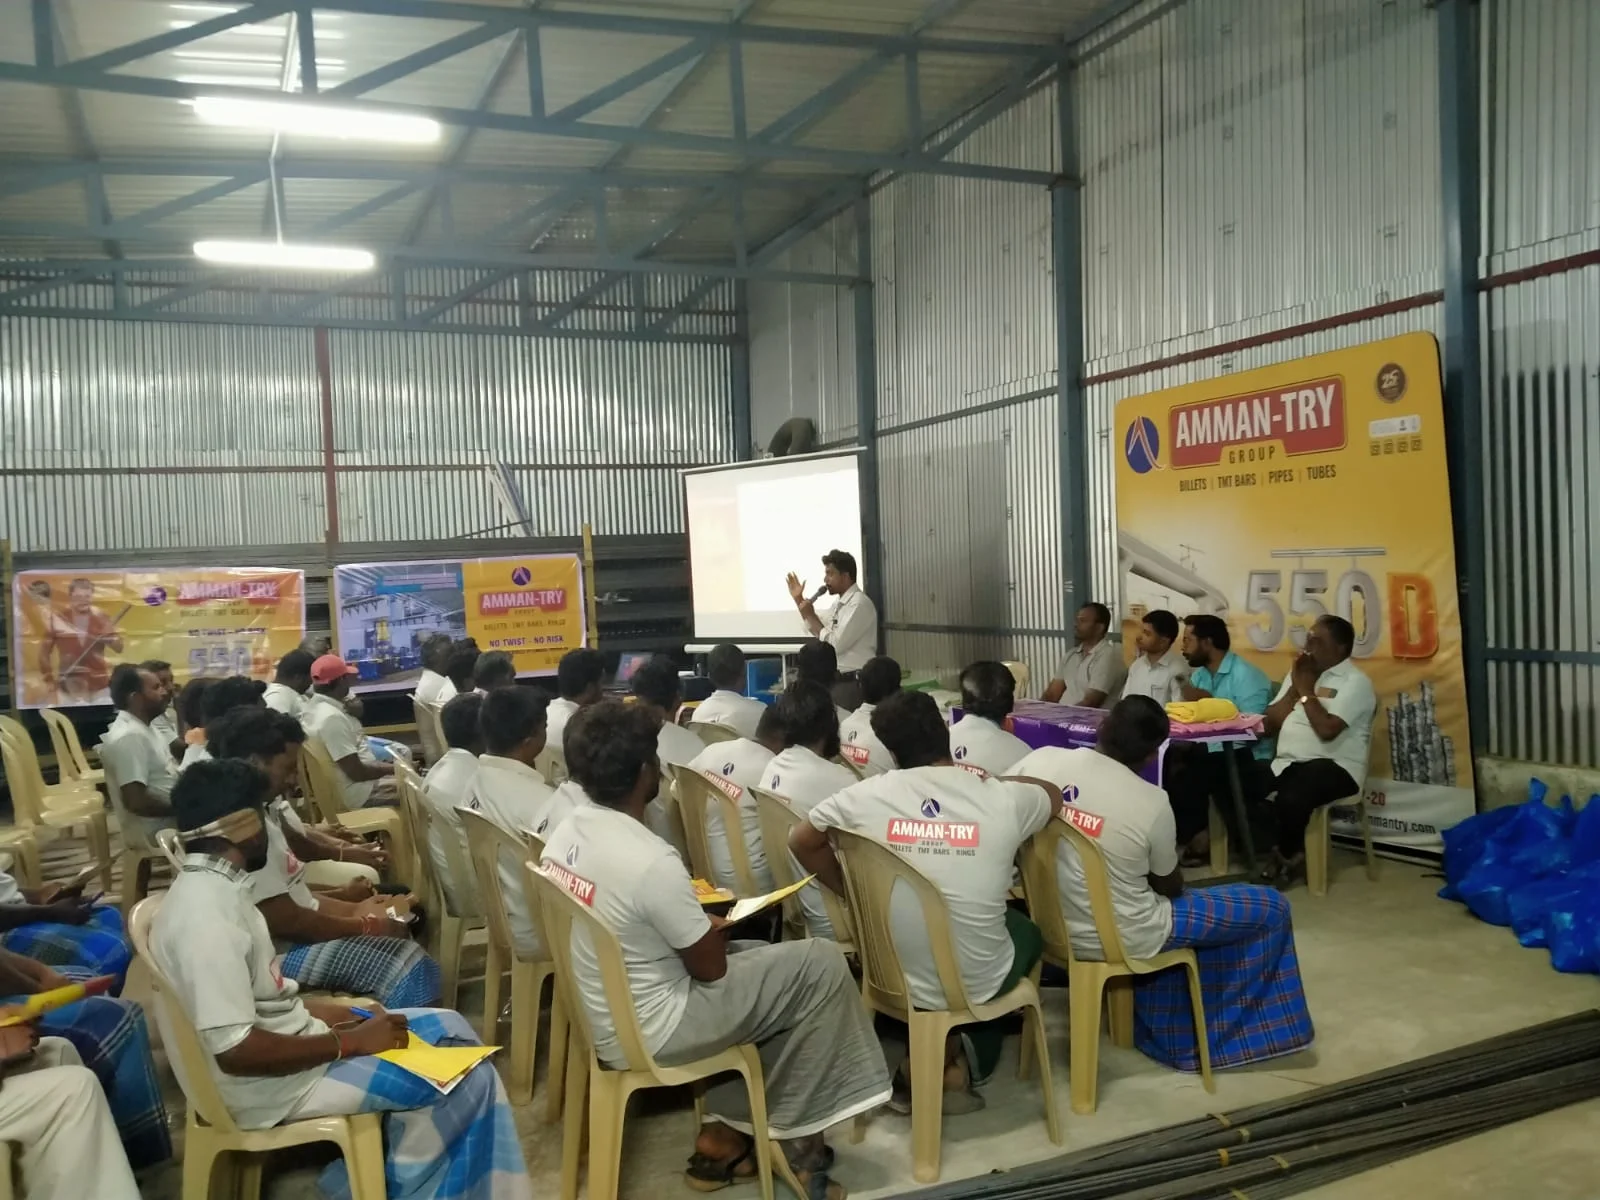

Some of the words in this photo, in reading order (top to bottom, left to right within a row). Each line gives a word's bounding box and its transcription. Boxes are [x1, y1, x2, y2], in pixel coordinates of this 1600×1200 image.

[1176, 384, 1337, 449] AMMAN-TRY
[1229, 445, 1276, 464] GROUP
[1179, 478, 1208, 492] BILLETS
[1217, 475, 1233, 489] TMT
[1235, 473, 1257, 487] BARS
[1268, 469, 1294, 484] PIPES
[1307, 464, 1337, 480] TUBES
[482, 590, 564, 609] AMMAN-TRY
[489, 639, 500, 648] NO
[503, 637, 526, 647] TWIST
[534, 636, 544, 645] NO
[1061, 806, 1101, 831] AN-TRY
[891, 820, 975, 840] AMMAN-TRY
